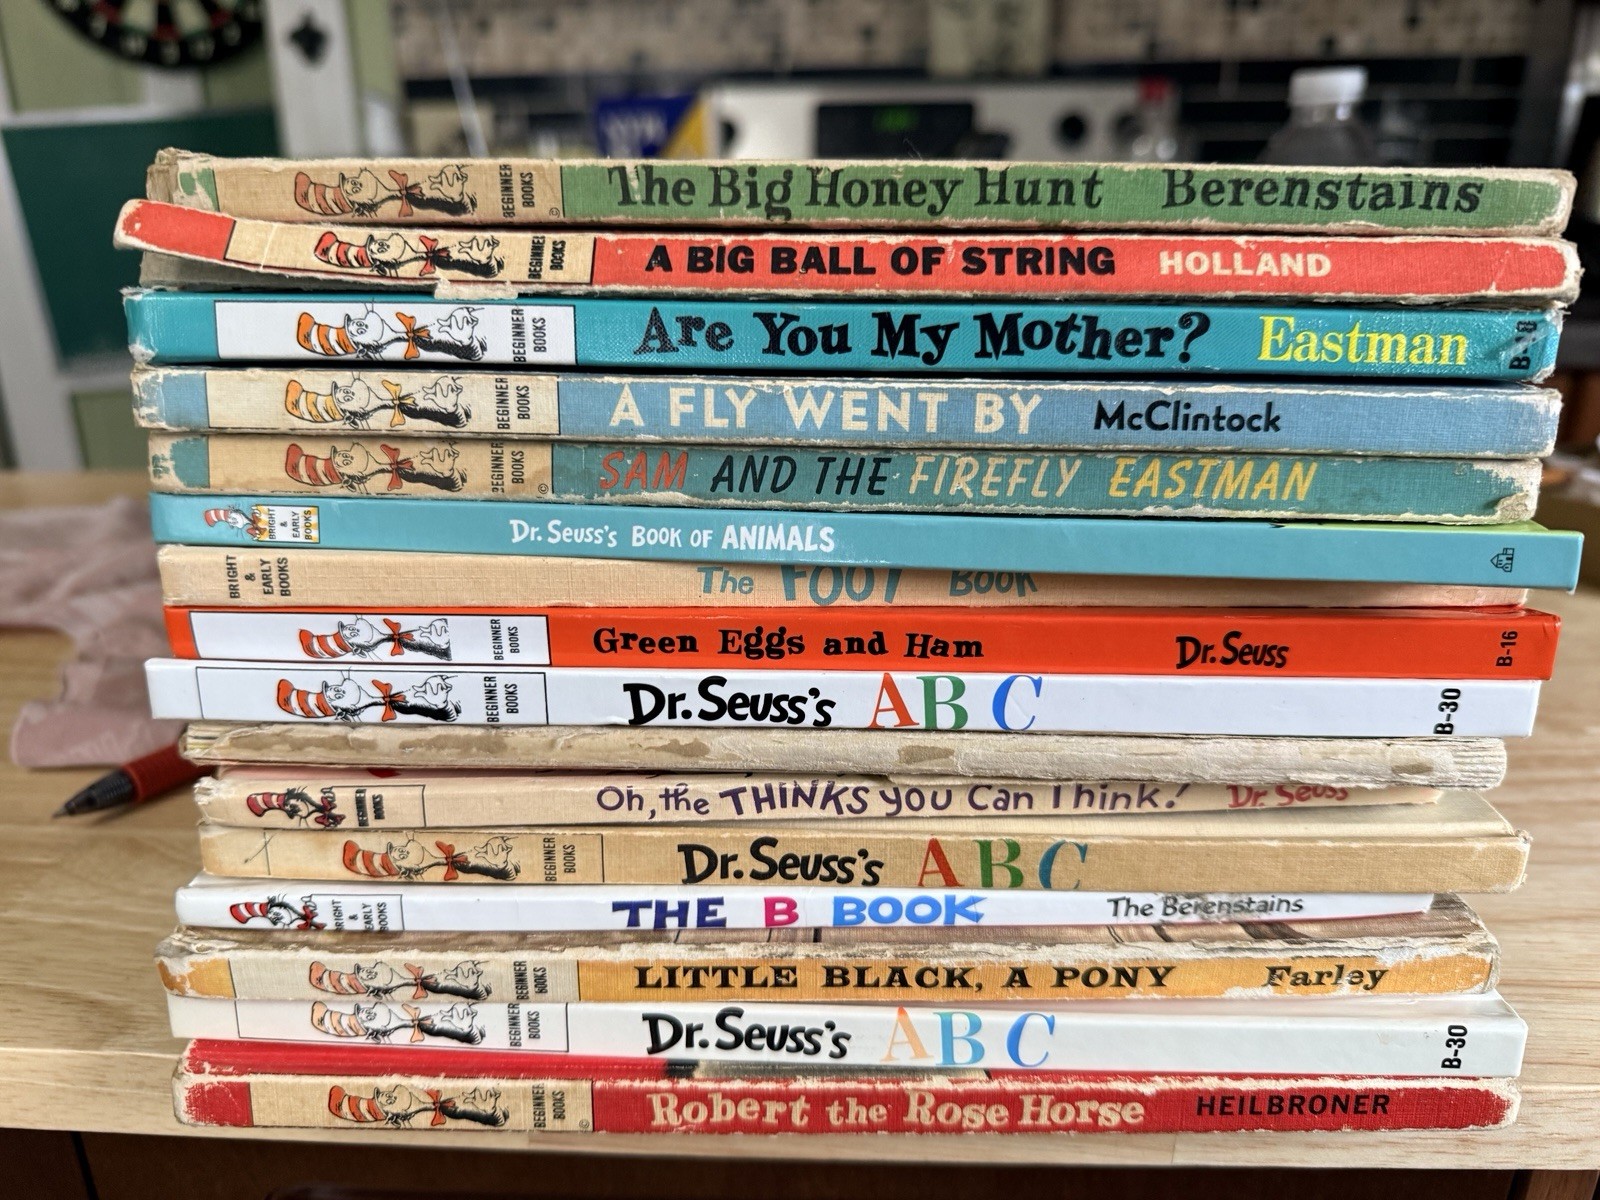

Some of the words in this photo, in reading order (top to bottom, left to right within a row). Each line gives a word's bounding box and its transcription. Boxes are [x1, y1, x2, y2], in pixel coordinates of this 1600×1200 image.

[499, 164, 516, 218] BEGINNER
[520, 172, 535, 208] BOOKS
[608, 165, 697, 207] The
[708, 166, 793, 220] Big
[806, 166, 963, 216] Honey
[974, 167, 1103, 208] Hunt
[1162, 169, 1483, 213] Berenstains
[645, 245, 673, 272] A
[687, 246, 754, 273] BIG
[770, 247, 876, 275] BALL
[891, 247, 945, 275] OF
[961, 247, 1115, 276] STRING
[1159, 250, 1332, 278] HOLLAND
[511, 308, 527, 363] BEGINNER
[532, 317, 547, 353] BOOKS
[633, 307, 734, 355] Are
[752, 312, 852, 357] You
[871, 312, 961, 365] My
[973, 311, 1210, 364] Mother?
[1258, 315, 1467, 366] Eastman
[495, 377, 510, 430] BEGINNER
[516, 385, 530, 420] BOOKS
[609, 383, 644, 427] A
[669, 387, 758, 429] FLY
[782, 389, 952, 433] WENT
[974, 393, 1042, 435] BY
[1094, 400, 1281, 433] McClintock
[511, 450, 525, 484] BOOKS
[599, 450, 690, 490] SAM
[709, 455, 798, 495] AND
[815, 456, 892, 496] THE
[908, 455, 1083, 498] FIREFLY
[1108, 458, 1319, 501] EASTMAN
[267, 508, 276, 540] BRIGHT
[291, 510, 300, 538] EARLY
[303, 509, 313, 540] BOOKS
[509, 519, 542, 544] Dr.
[632, 525, 682, 548] BOOK
[722, 524, 836, 553] ANIMALS
[226, 555, 240, 599] BRIGHT
[244, 572, 256, 582] &
[260, 558, 274, 595] EARLY
[277, 557, 291, 597] BOOKS
[697, 566, 754, 594] The
[490, 618, 504, 660] BEGINNER
[507, 626, 520, 654] BOOKS
[593, 627, 700, 654] Green
[717, 625, 806, 660] Eggs
[823, 631, 889, 657] and
[904, 633, 984, 659] Ham
[1175, 636, 1217, 670] Dr.
[1219, 630, 1290, 669] Seuss
[1495, 630, 1518, 667] B-16
[484, 675, 500, 723] BEGINNER
[504, 683, 519, 714] BOOKS
[623, 682, 692, 726] Dr.
[698, 676, 836, 728] Seuss's
[1433, 688, 1462, 736] B-30
[597, 785, 656, 820] Oh,
[659, 782, 710, 815] the
[719, 779, 870, 816] THINKS
[879, 788, 952, 816] you
[967, 784, 1034, 811] Can
[1226, 784, 1268, 808] Dr.
[1275, 784, 1348, 806] Seuss
[543, 836, 557, 883] BEGINNER
[563, 843, 577, 874] BOOKS
[677, 843, 744, 884] Dr.
[750, 837, 884, 886] Seuss's
[362, 903, 374, 930] EARLY
[611, 896, 728, 930] THE
[764, 897, 799, 928] B
[832, 894, 988, 927] BOOK
[1107, 896, 1154, 917] The
[1161, 895, 1304, 916] Berenstains
[513, 960, 530, 1000] BEGINNER
[533, 966, 548, 995] BOOKS
[634, 965, 798, 990] LITTLE
[820, 965, 984, 992] BLACK,
[1004, 966, 1030, 989] A
[1052, 965, 1176, 988] PONY
[1263, 964, 1389, 991] Farley
[508, 1002, 522, 1047] BEGINNER
[527, 1010, 540, 1040] BOOKS
[642, 1012, 710, 1055] Dr.
[714, 1007, 852, 1059] Seuss's
[1441, 1024, 1469, 1070] B-30
[552, 1090, 565, 1120] BOOKS
[646, 1092, 811, 1127] Robert
[825, 1097, 888, 1125] the
[902, 1088, 1009, 1126] Rose
[1017, 1092, 1145, 1126] Horse
[1196, 1093, 1391, 1117] HEILBRONER
